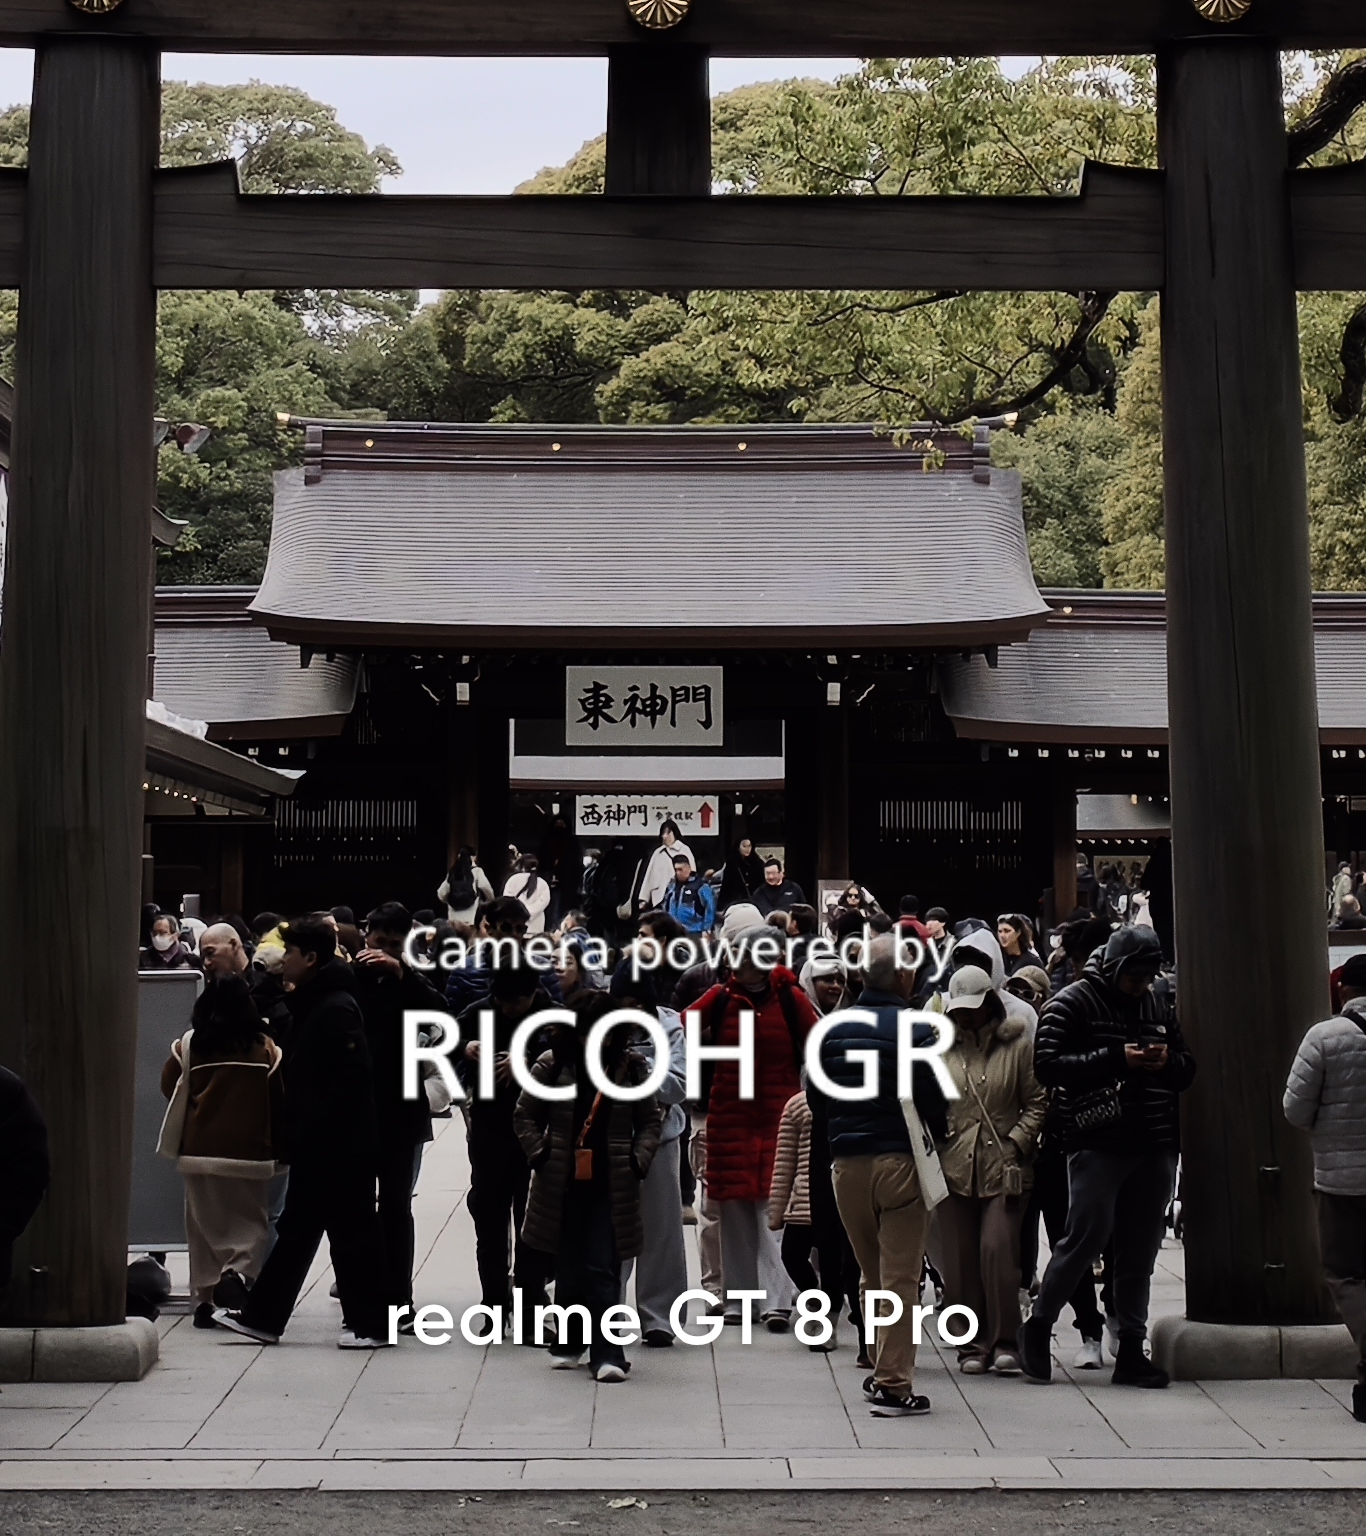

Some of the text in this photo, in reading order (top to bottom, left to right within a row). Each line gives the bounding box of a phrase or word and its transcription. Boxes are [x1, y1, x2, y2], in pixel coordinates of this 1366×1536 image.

[575, 680, 714, 731] 東神門
[579, 802, 649, 827] 西神門
